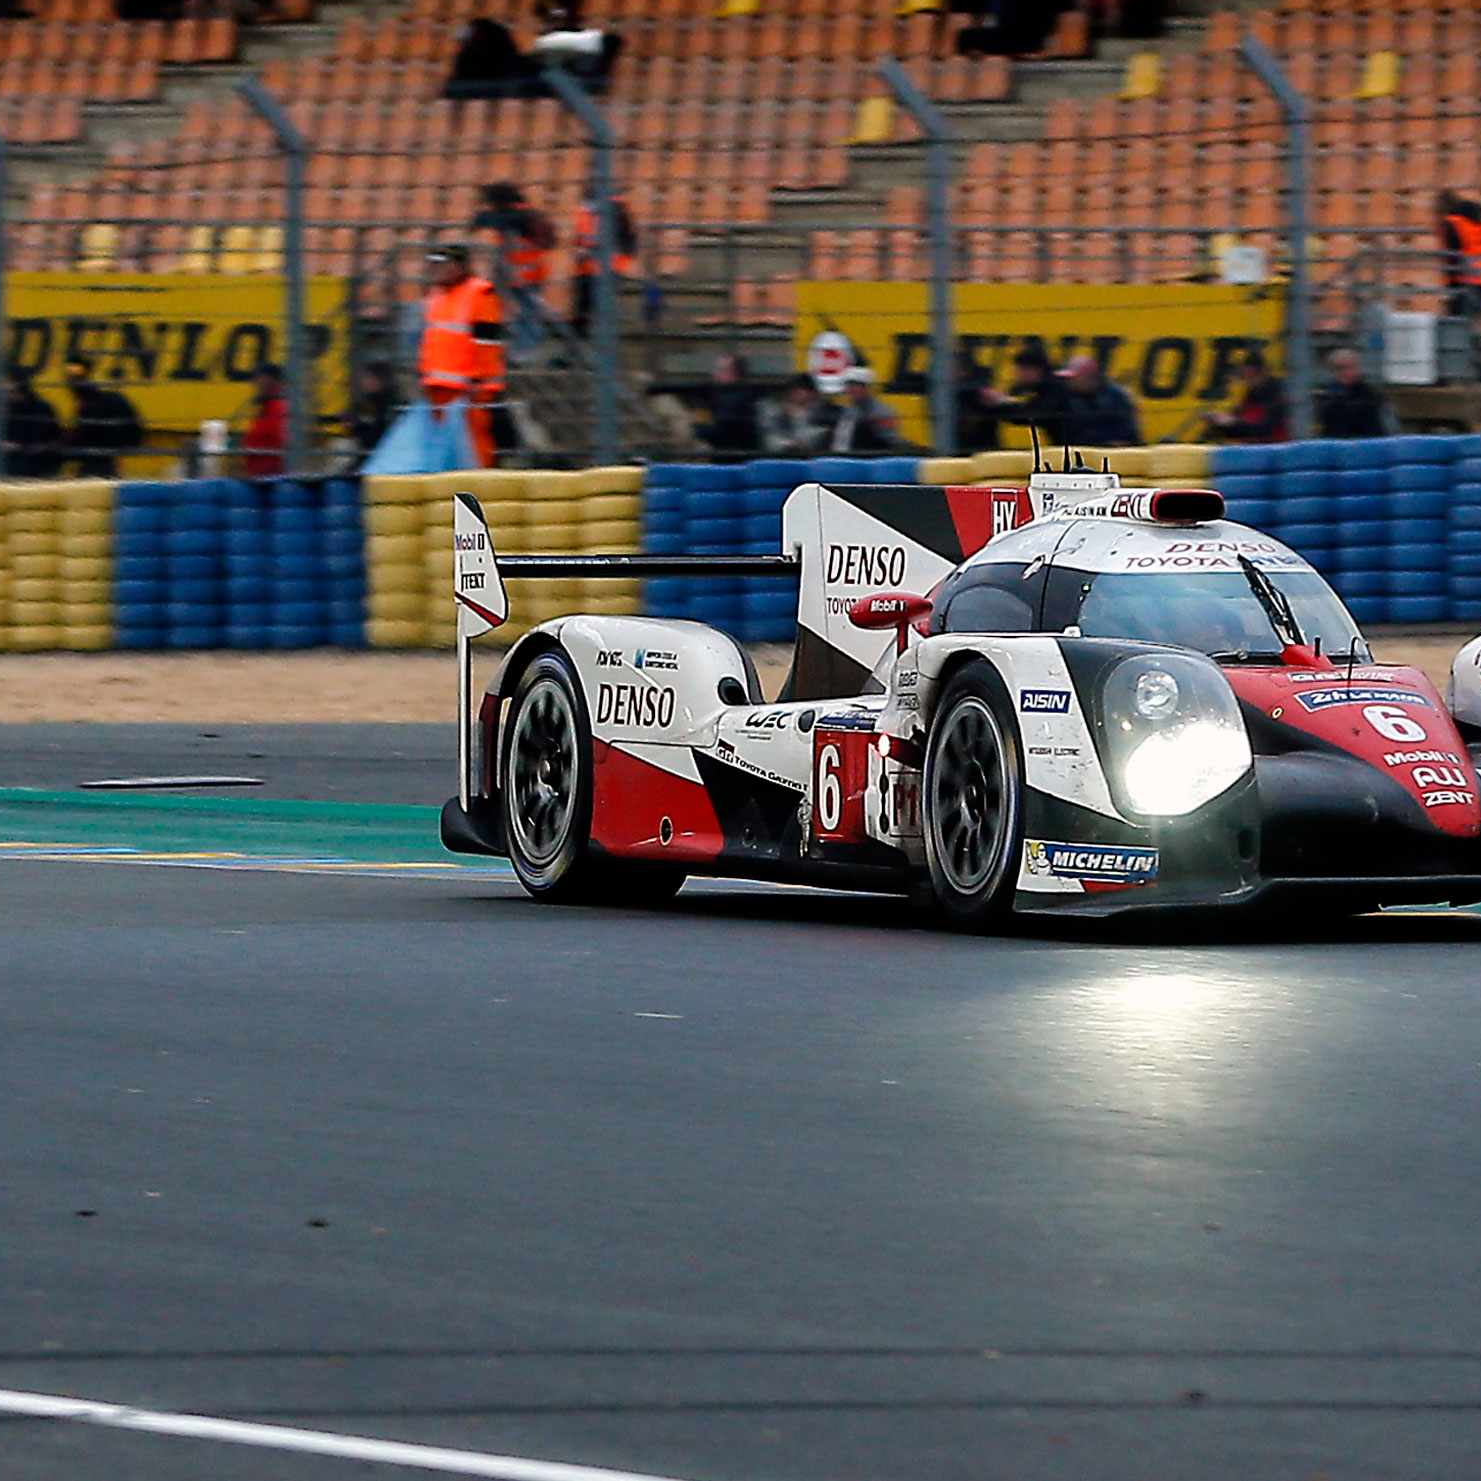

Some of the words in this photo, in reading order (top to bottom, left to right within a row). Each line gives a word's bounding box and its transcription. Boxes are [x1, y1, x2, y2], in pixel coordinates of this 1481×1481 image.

[1165, 542, 1277, 553] DENSO
[827, 545, 905, 586] DENSO
[1125, 557, 1230, 569] TOYOTA
[596, 683, 674, 728] DENSO
[1023, 693, 1066, 709] AISIN
[745, 710, 793, 730] WEC
[1362, 704, 1427, 743] 6
[1383, 751, 1445, 766] Mobil
[819, 744, 842, 831] 6
[1420, 791, 1475, 807] ZENT
[1052, 850, 1155, 872] MICHELIN
